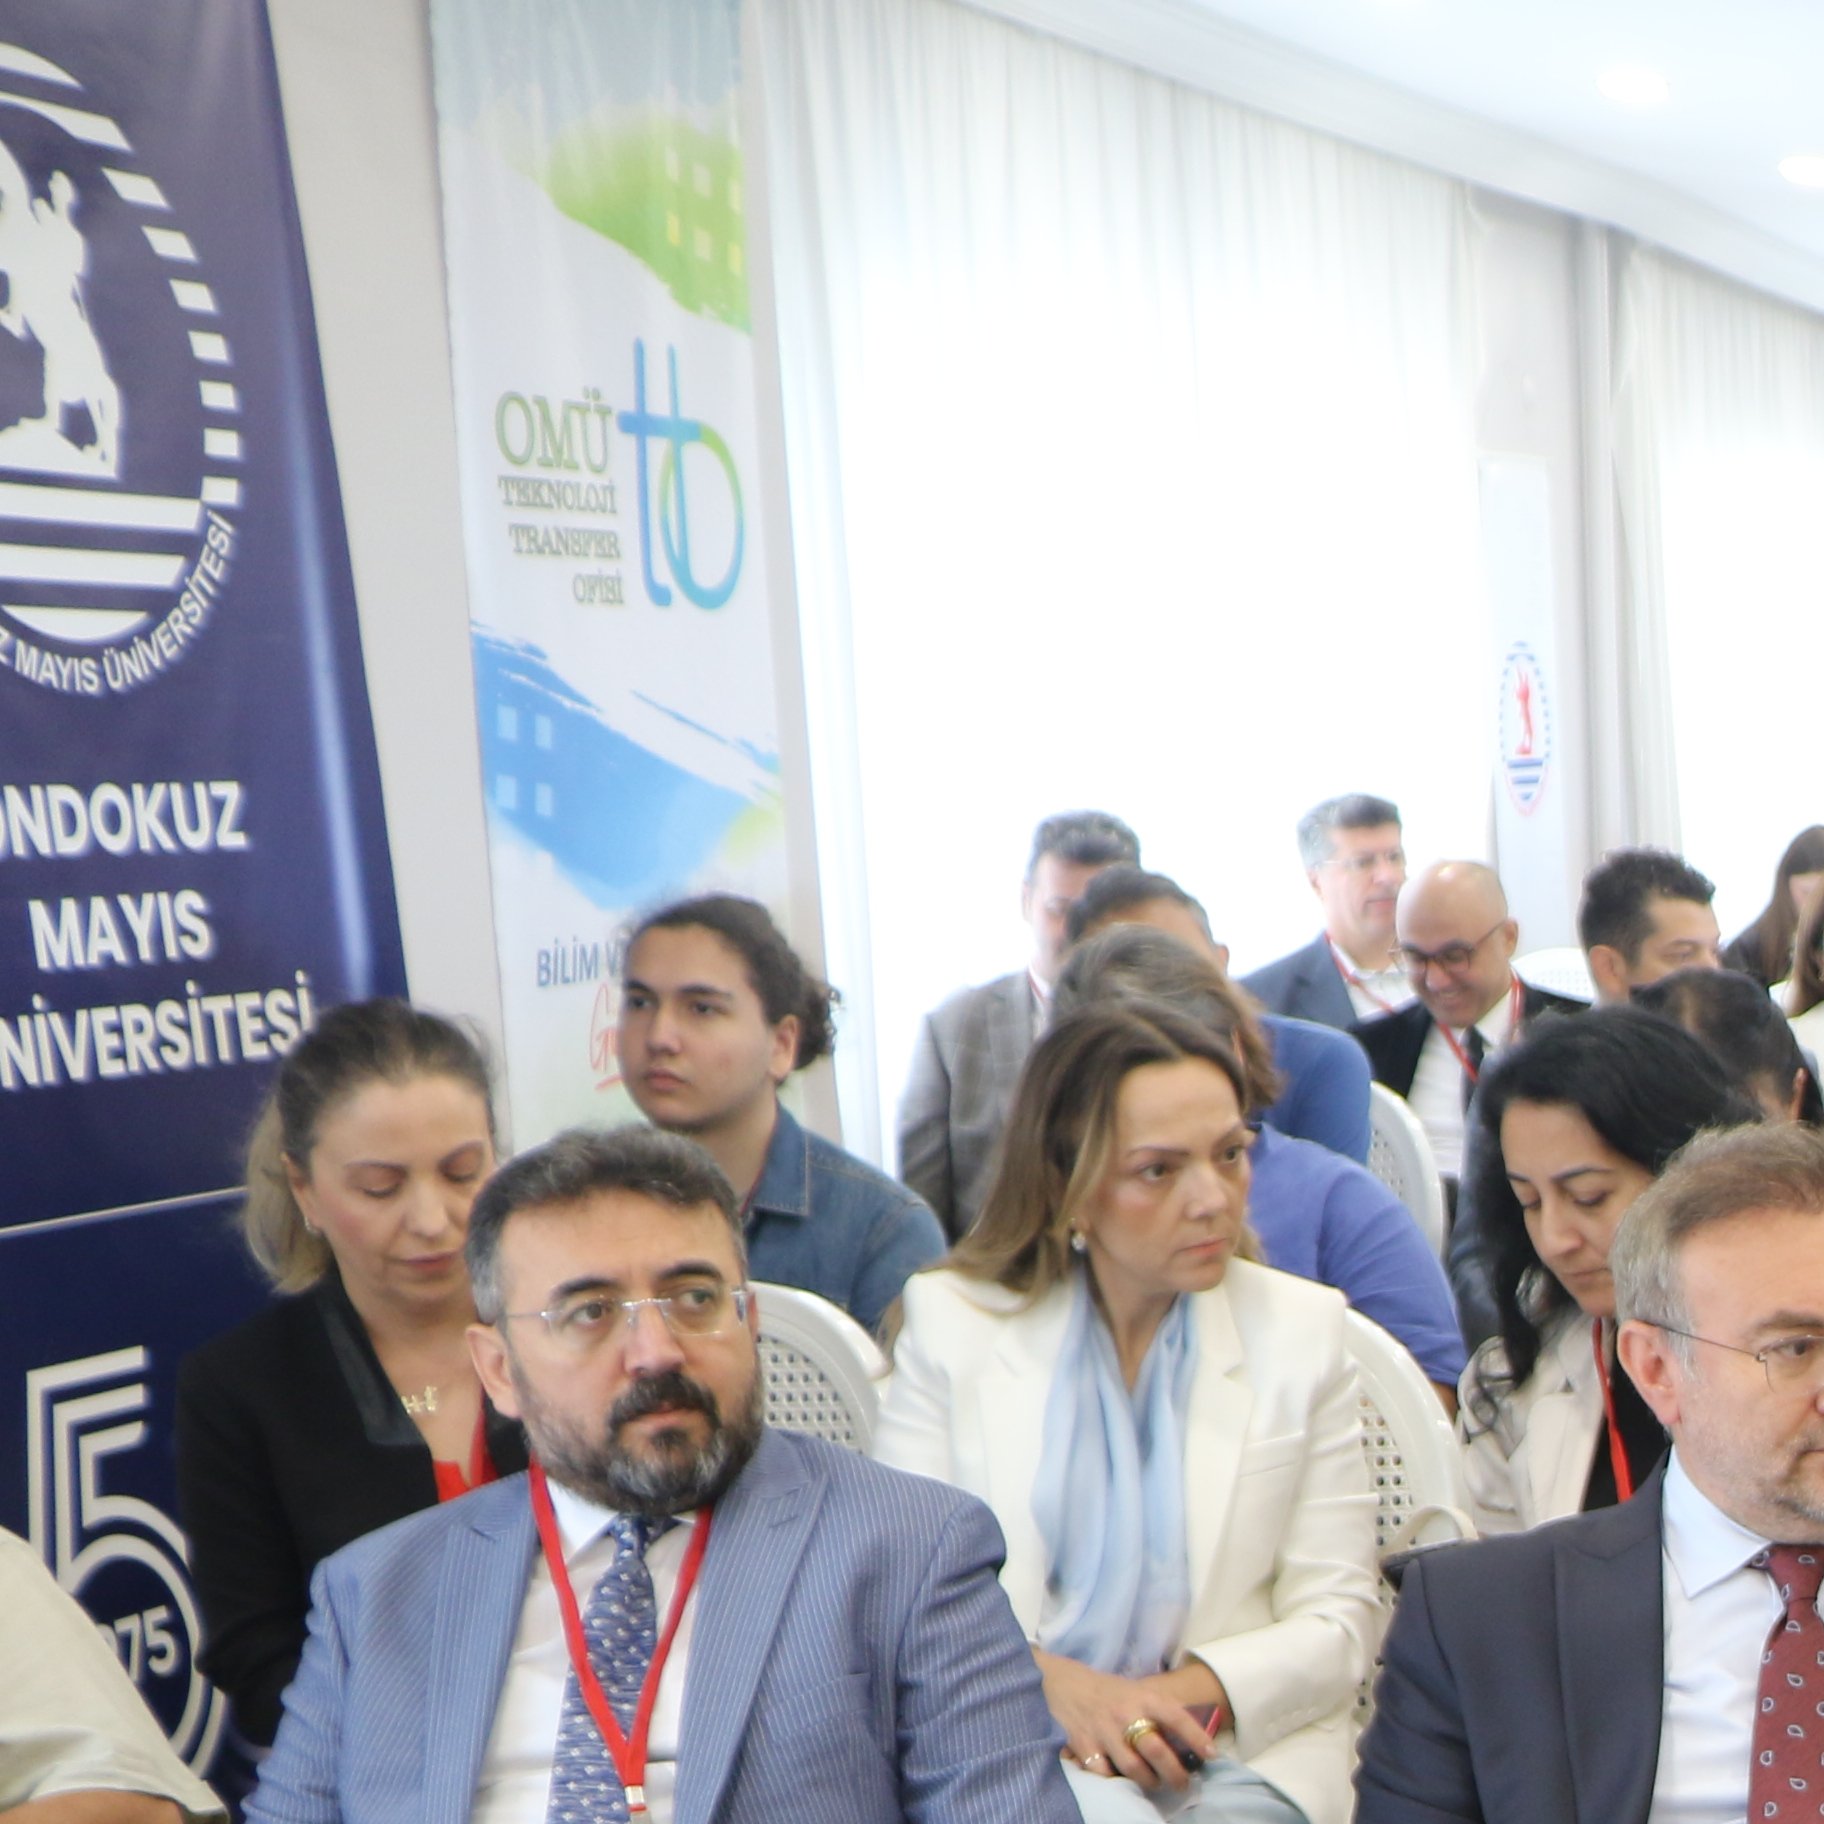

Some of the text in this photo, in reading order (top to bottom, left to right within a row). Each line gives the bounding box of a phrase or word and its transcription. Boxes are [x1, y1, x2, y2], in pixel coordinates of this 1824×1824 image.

[495, 387, 612, 473] OMÜ
[497, 472, 617, 515] TEKNOLOJİ
[508, 522, 622, 560] TRANSFER
[14, 508, 237, 697] MAYIS ÜNİVERSİTESİ
[572, 567, 624, 605] OFİSİ
[0, 780, 250, 857] NDOKUZ
[28, 888, 213, 971] MAYIS
[536, 934, 599, 987] BİLİM
[0, 968, 314, 1090] NİVERSİTESİ
